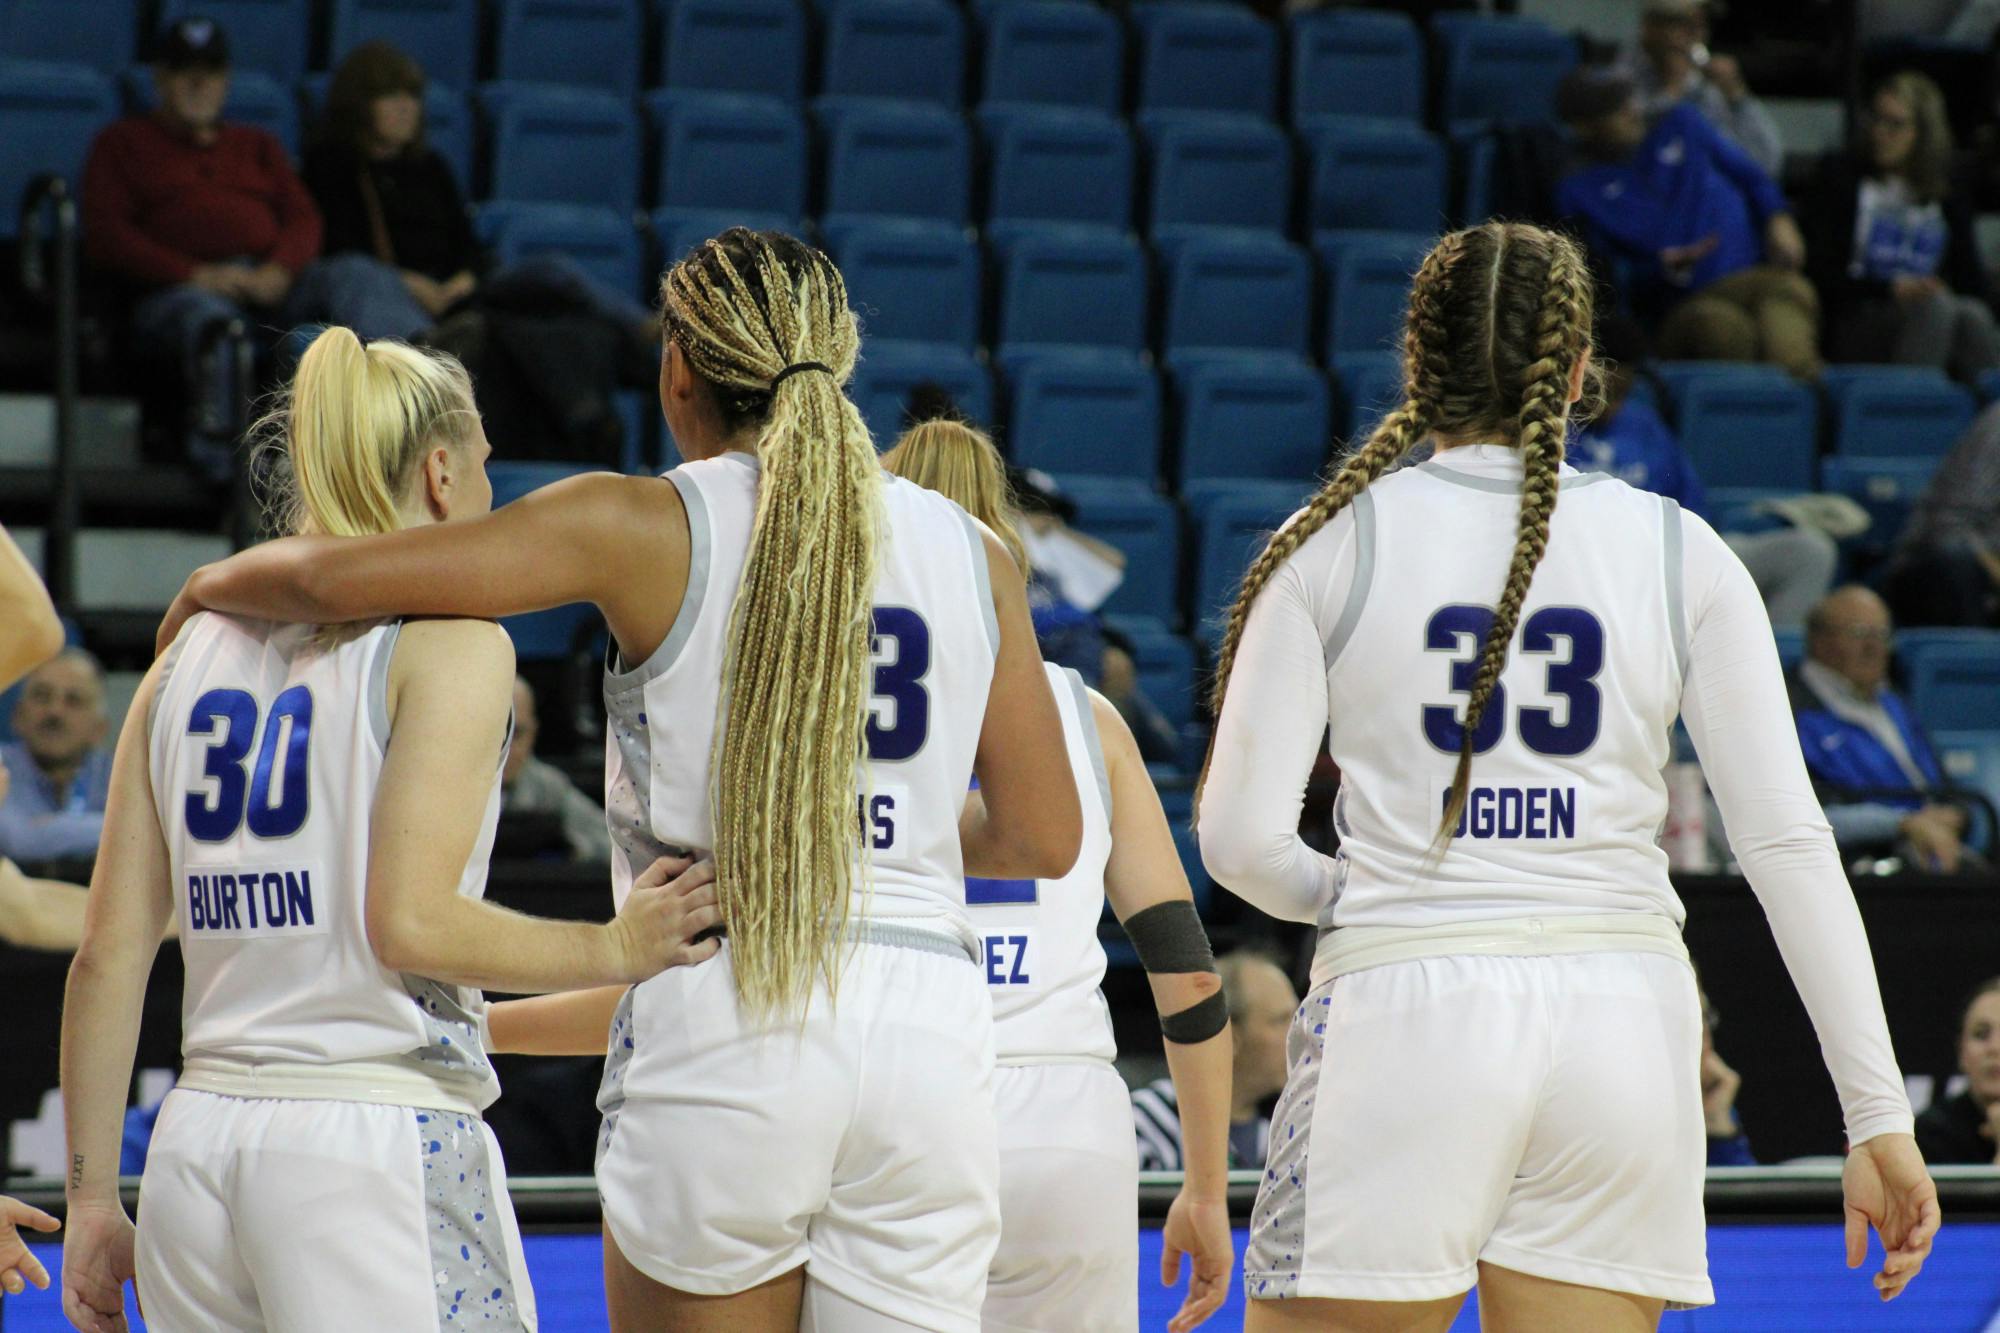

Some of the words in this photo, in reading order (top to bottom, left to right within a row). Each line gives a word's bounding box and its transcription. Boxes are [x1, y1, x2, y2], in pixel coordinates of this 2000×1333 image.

[1421, 602, 1606, 758] 33
[185, 684, 314, 845] 30
[188, 870, 315, 930] BURTON
[978, 935, 1030, 985] EZ
